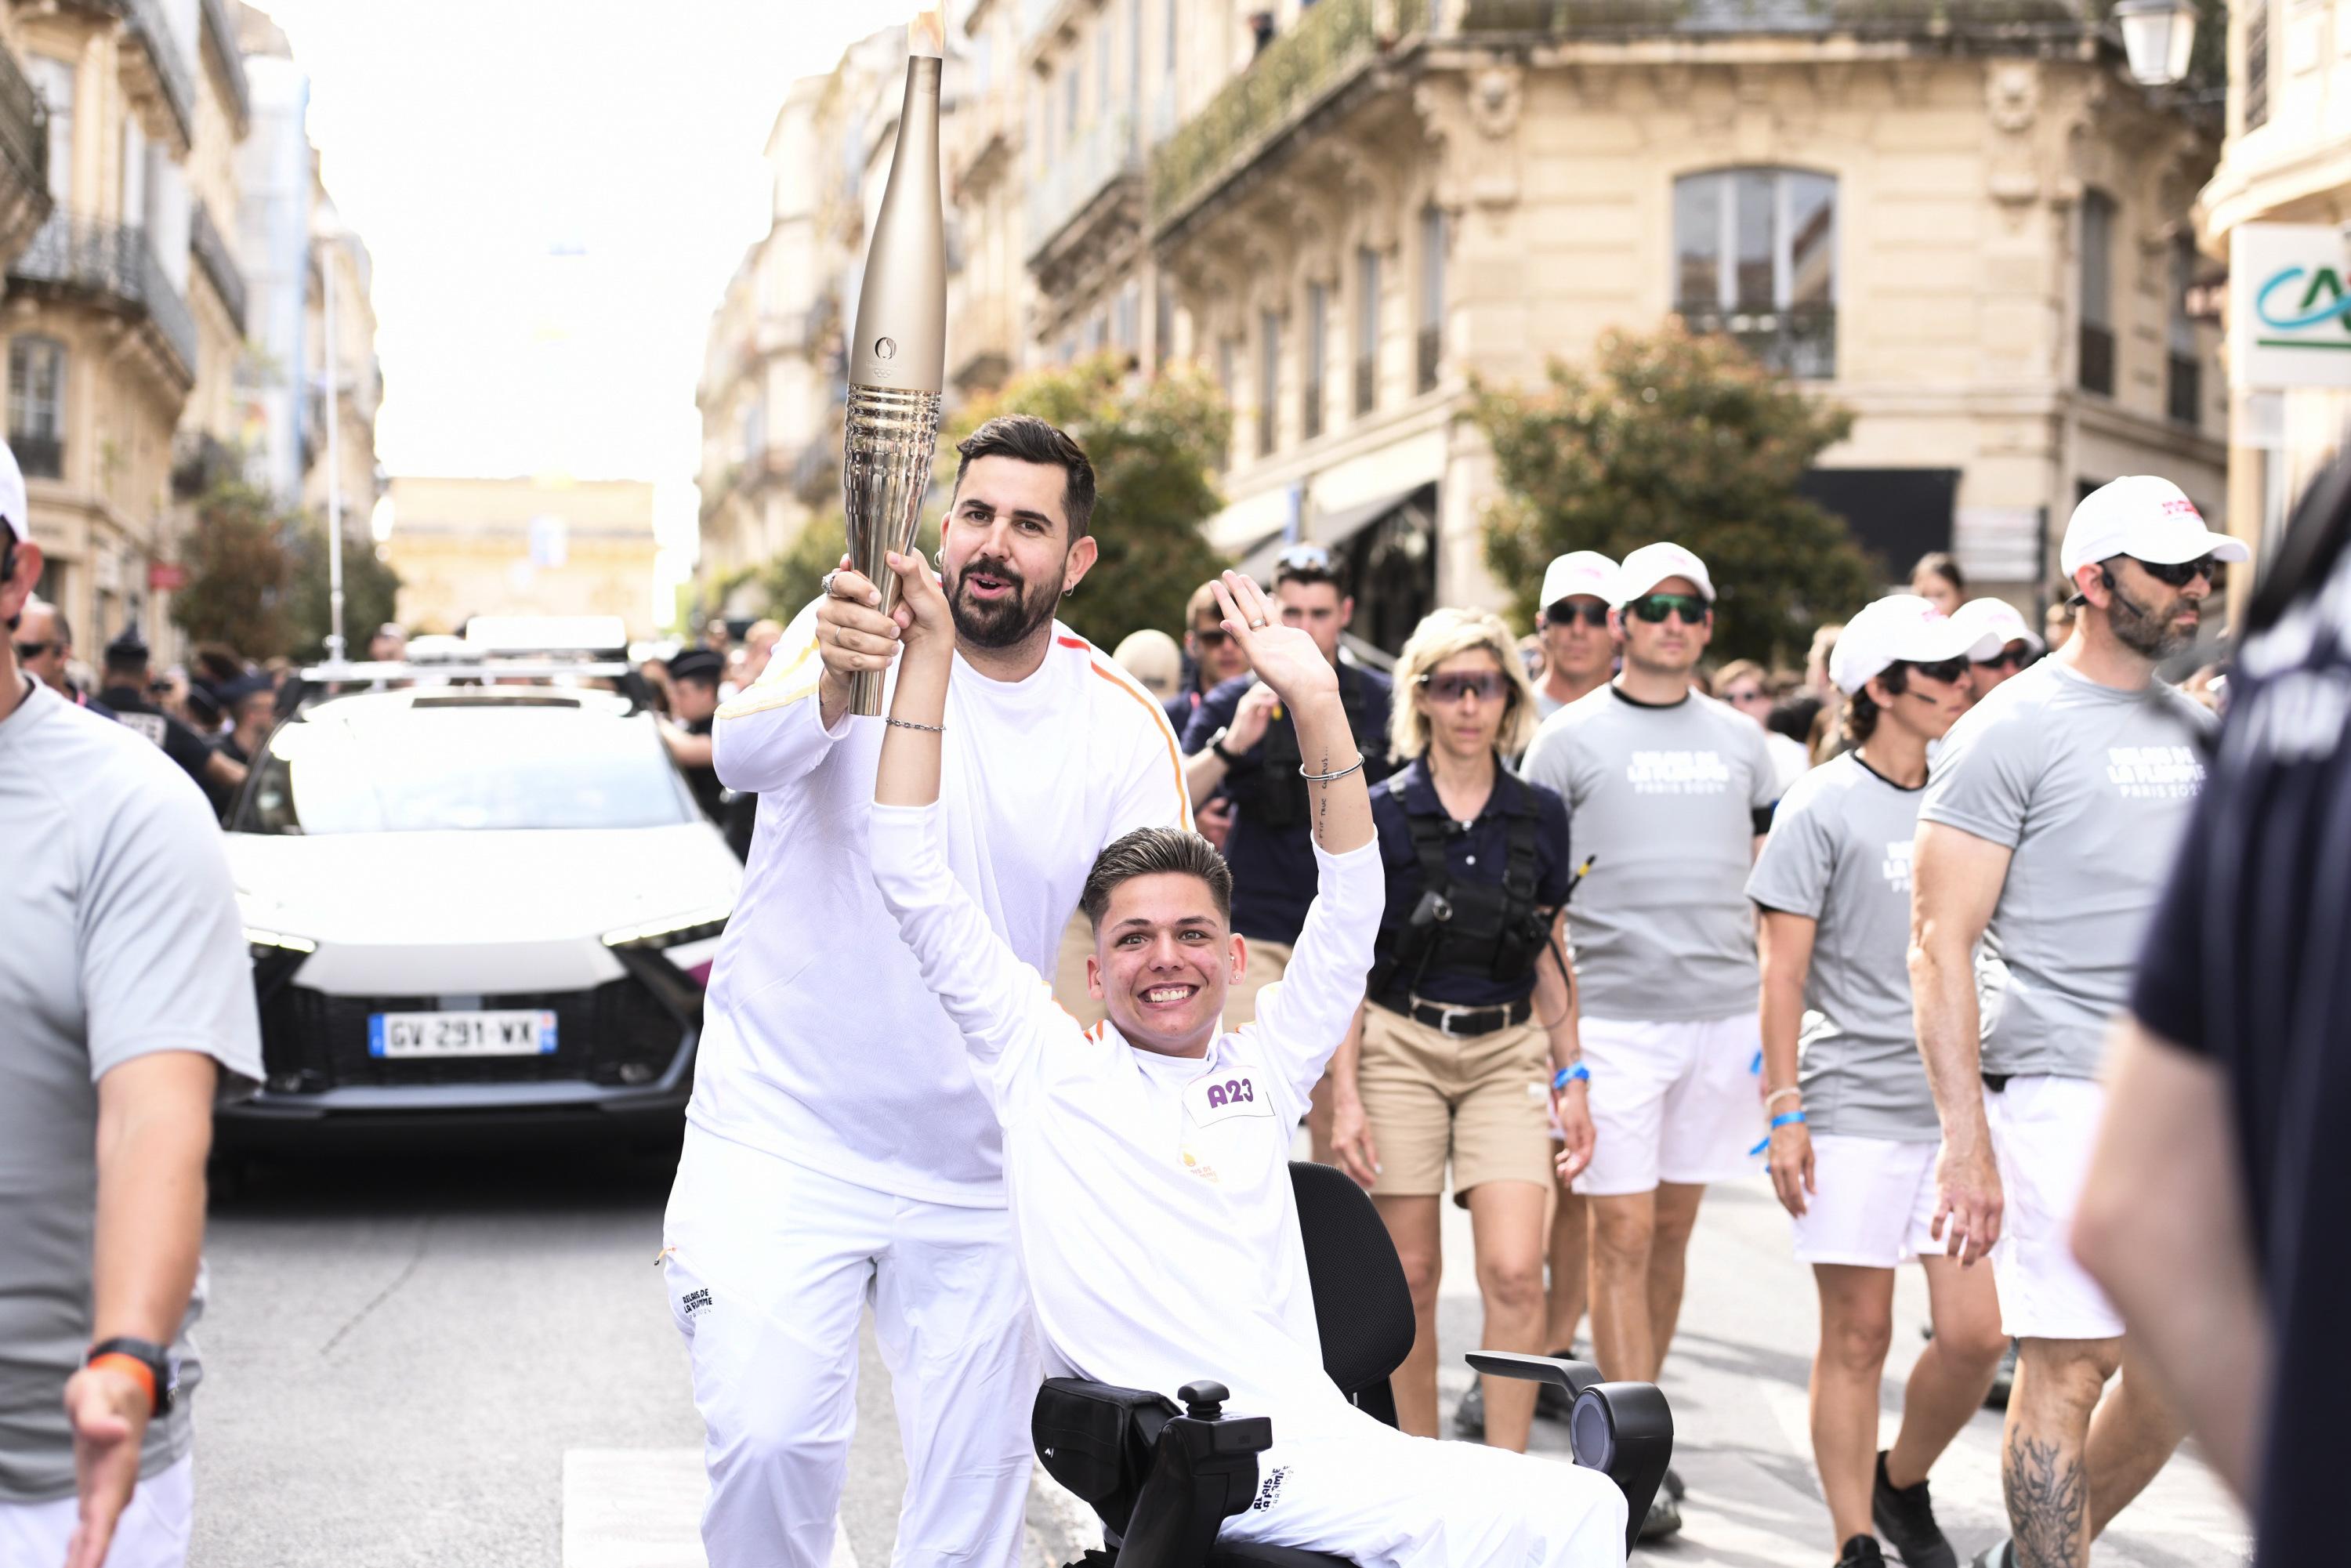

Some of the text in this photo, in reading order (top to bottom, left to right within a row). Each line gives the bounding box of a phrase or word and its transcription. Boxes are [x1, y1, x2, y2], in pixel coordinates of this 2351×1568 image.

[1207, 1077, 1254, 1109] A23
[683, 1287, 709, 1304] RELAIS DE
[683, 1305, 693, 1313] LA
